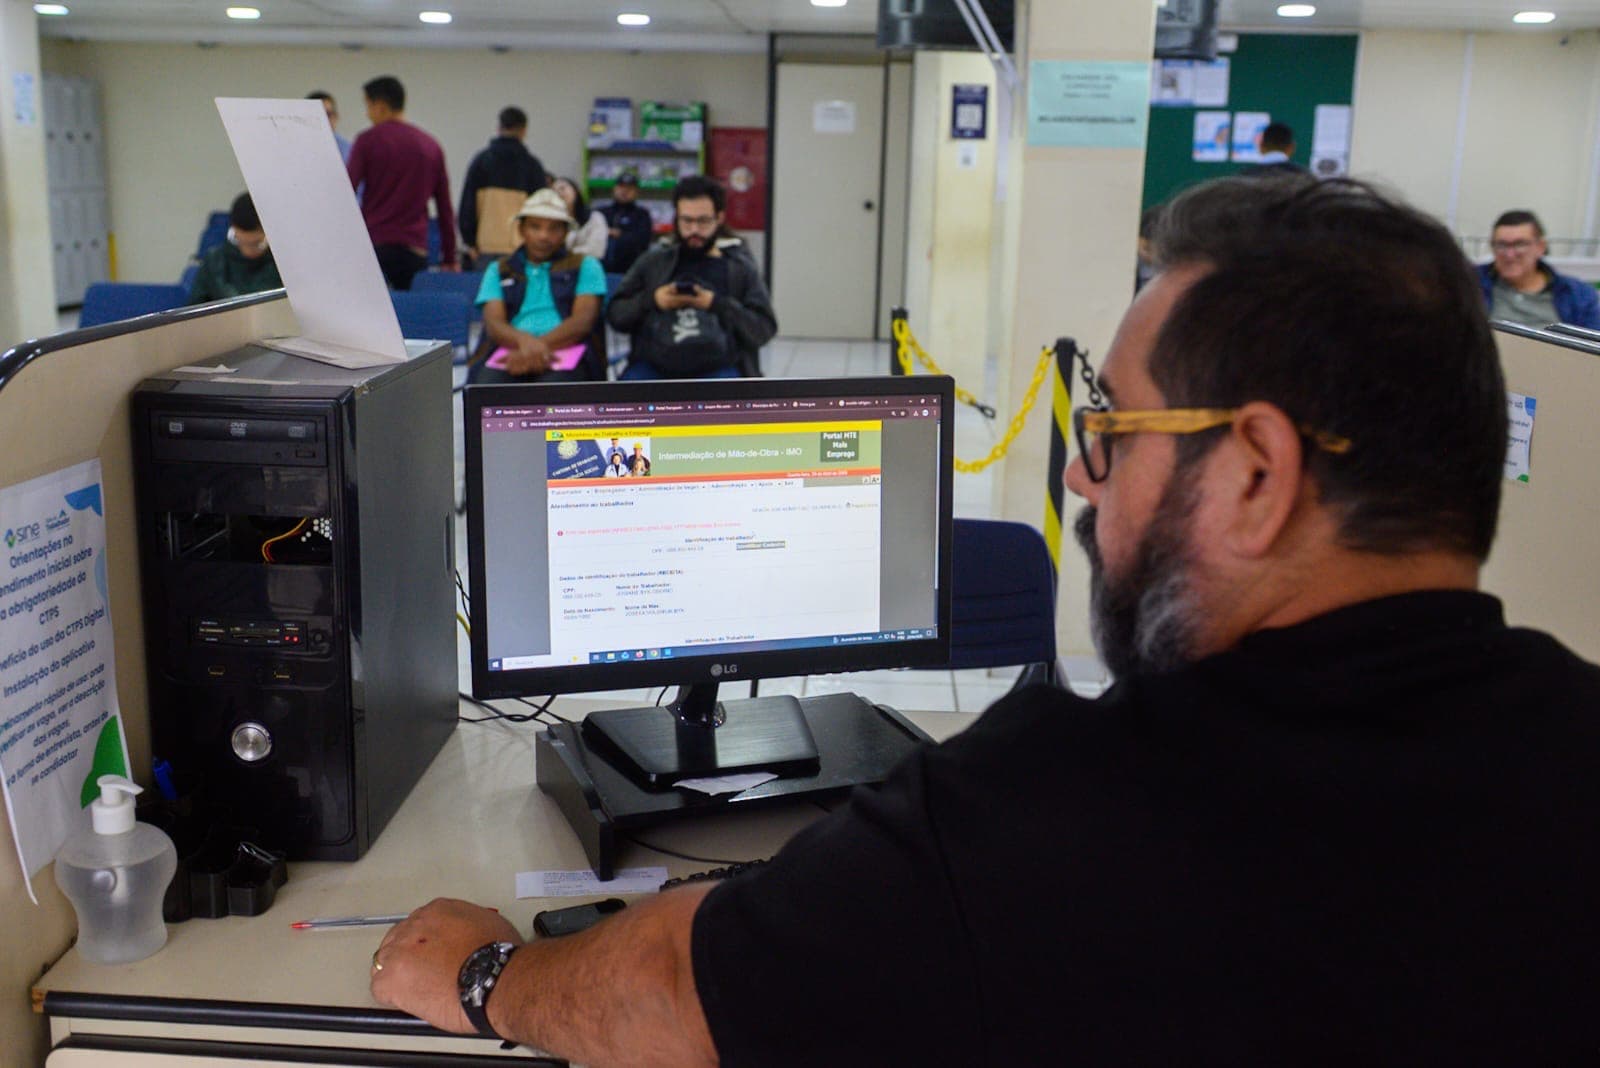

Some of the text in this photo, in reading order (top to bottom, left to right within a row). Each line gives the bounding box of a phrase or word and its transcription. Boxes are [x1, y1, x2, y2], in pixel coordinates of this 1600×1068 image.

[823, 431, 857, 440] Portal MTE
[658, 451, 715, 462] Intermediação
[716, 449, 727, 459] de
[727, 446, 779, 458] Mão-de-Obra
[786, 447, 802, 456] IMO
[826, 450, 856, 459] Emprego
[16, 522, 40, 542] sine
[10, 540, 61, 568] Orientações
[47, 555, 72, 577] inicial
[73, 547, 92, 565] sobre
[9, 577, 76, 617] obrigatoriedade
[39, 605, 59, 625] CTPS
[65, 618, 83, 637] CTPS
[84, 605, 105, 626] Digital
[3, 667, 49, 698] Instalação
[61, 639, 96, 669] aplicativo
[723, 664, 738, 674] LG
[39, 748, 78, 780] candidatar
